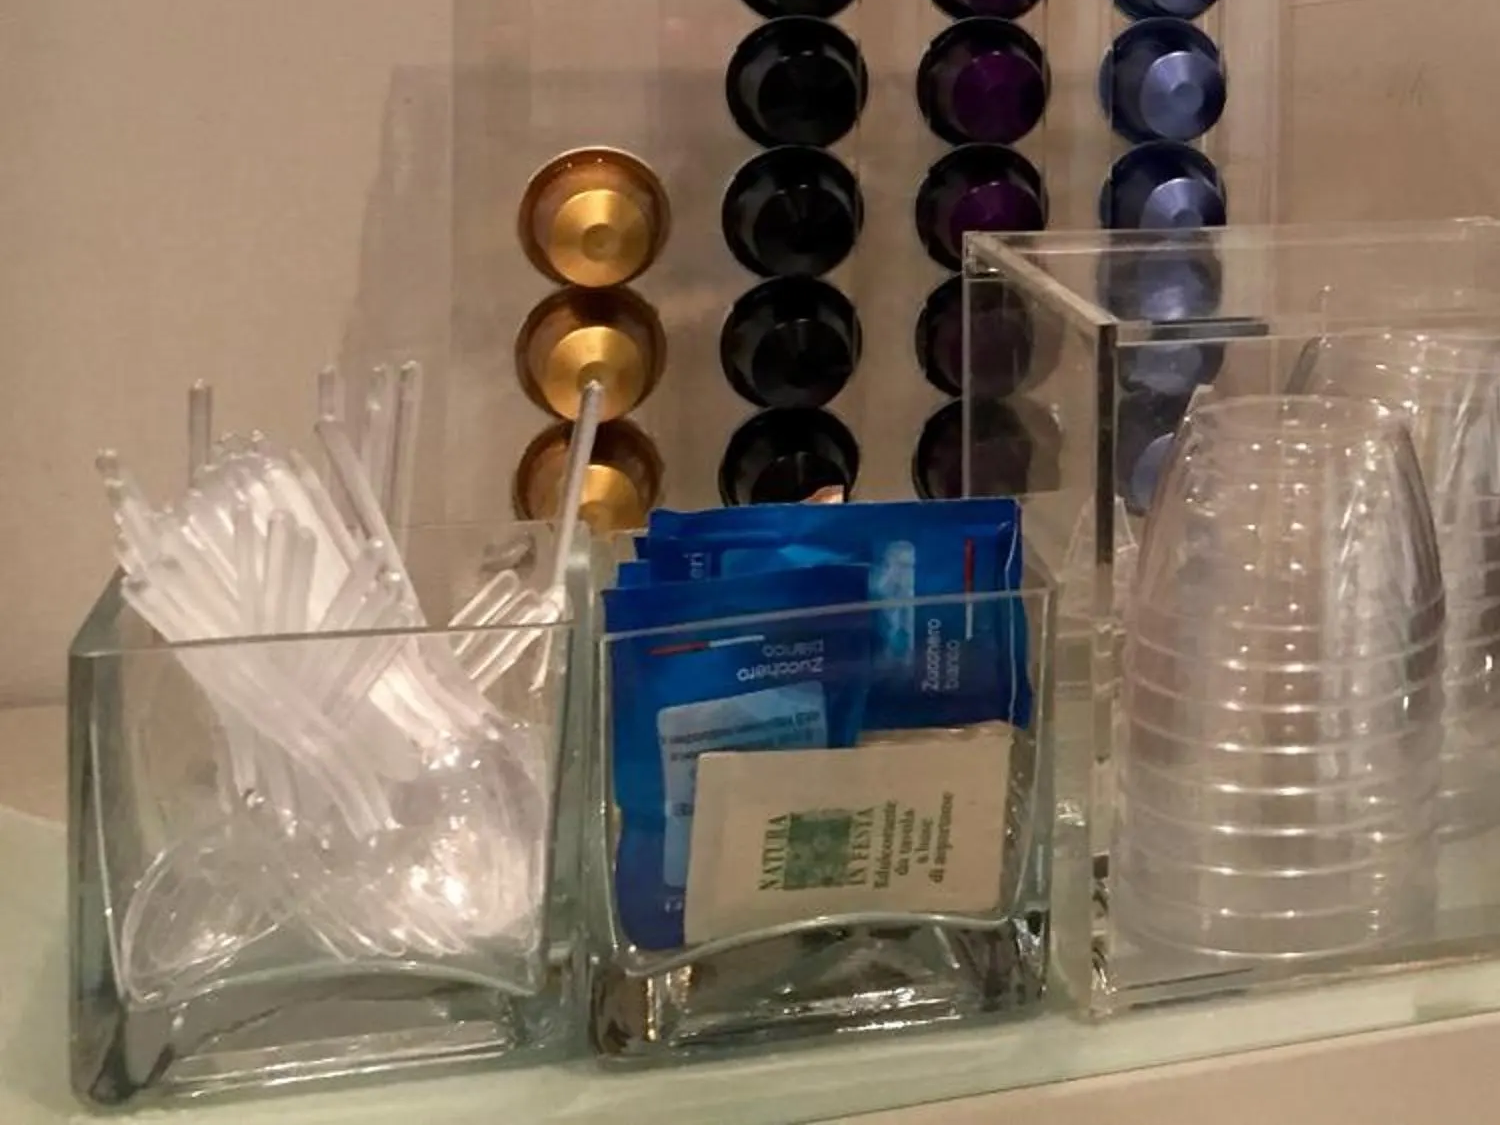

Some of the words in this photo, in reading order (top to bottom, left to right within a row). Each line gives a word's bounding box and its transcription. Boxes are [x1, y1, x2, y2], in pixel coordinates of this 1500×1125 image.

[736, 656, 824, 682] Zucchero
[757, 814, 788, 891] NATURA
[849, 806, 874, 862] FESTA
